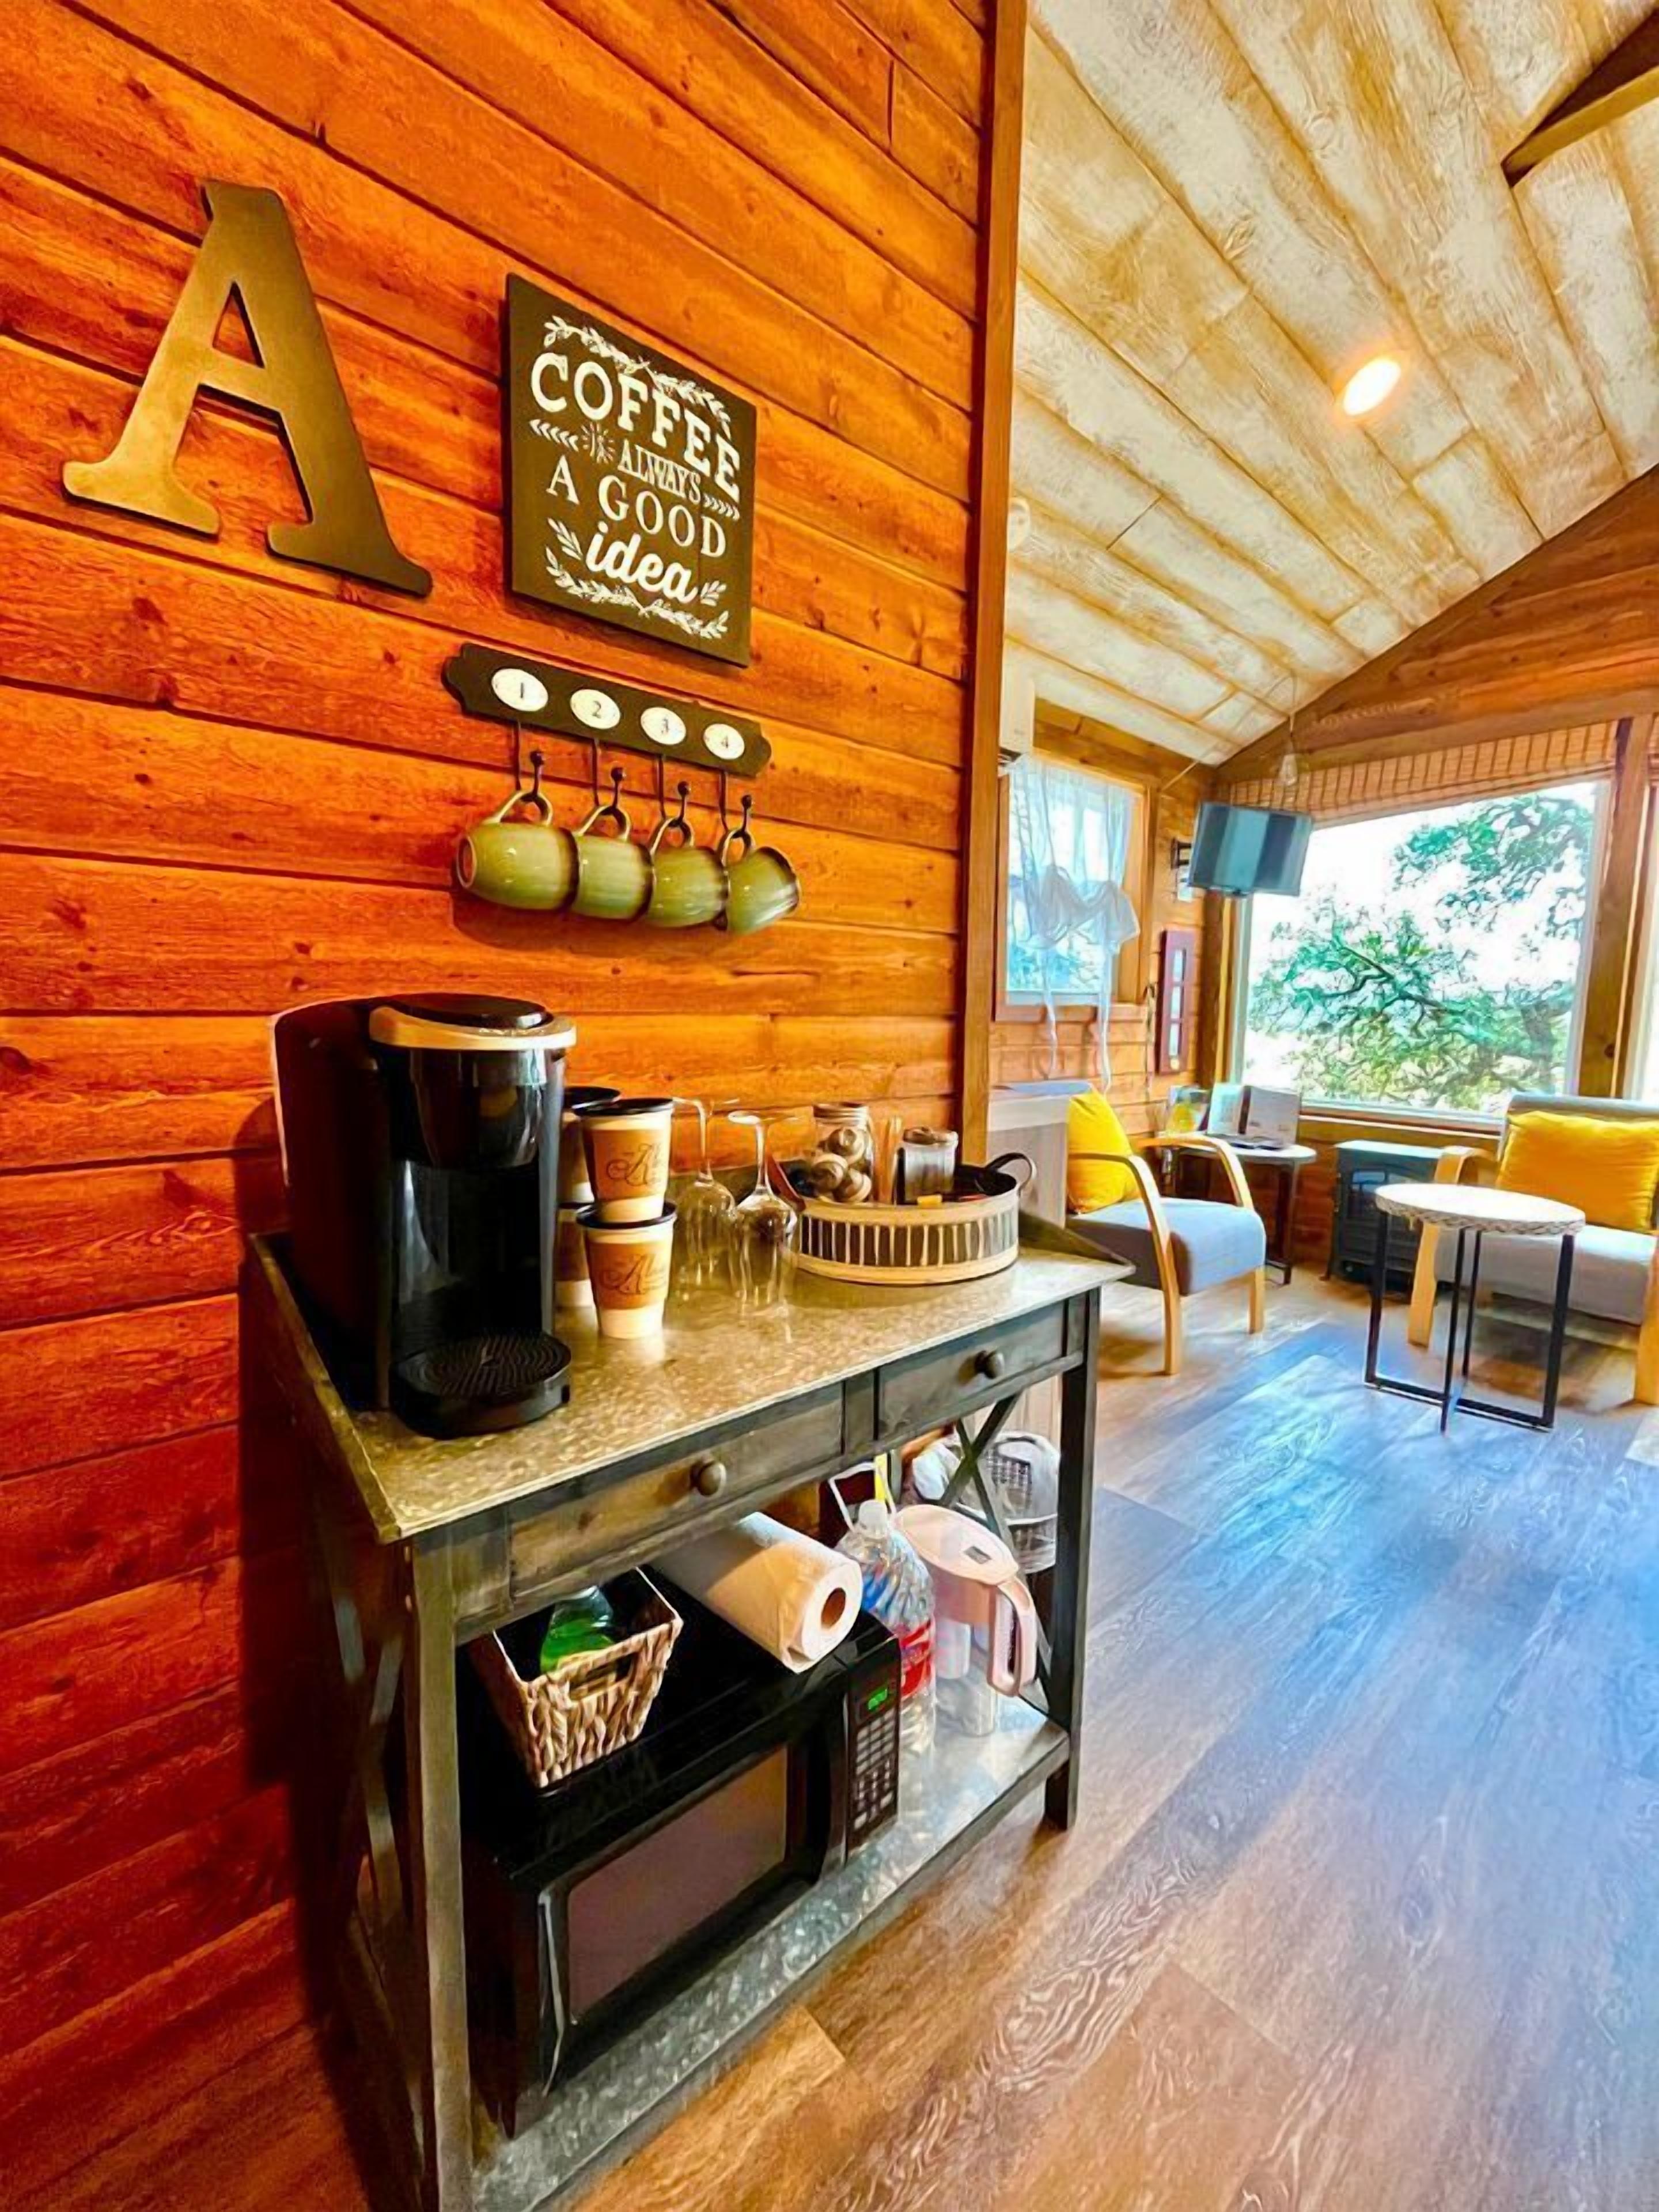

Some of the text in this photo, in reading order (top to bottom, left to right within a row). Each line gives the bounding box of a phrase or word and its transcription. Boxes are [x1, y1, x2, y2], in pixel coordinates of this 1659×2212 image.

[62, 180, 433, 596] A
[531, 352, 740, 503] COFFEE
[546, 455, 726, 558] A GOOD
[617, 438, 701, 505] ALWAYS
[585, 521, 699, 603] idea
[592, 700, 601, 719] 2
[660, 717, 670, 733] 3
